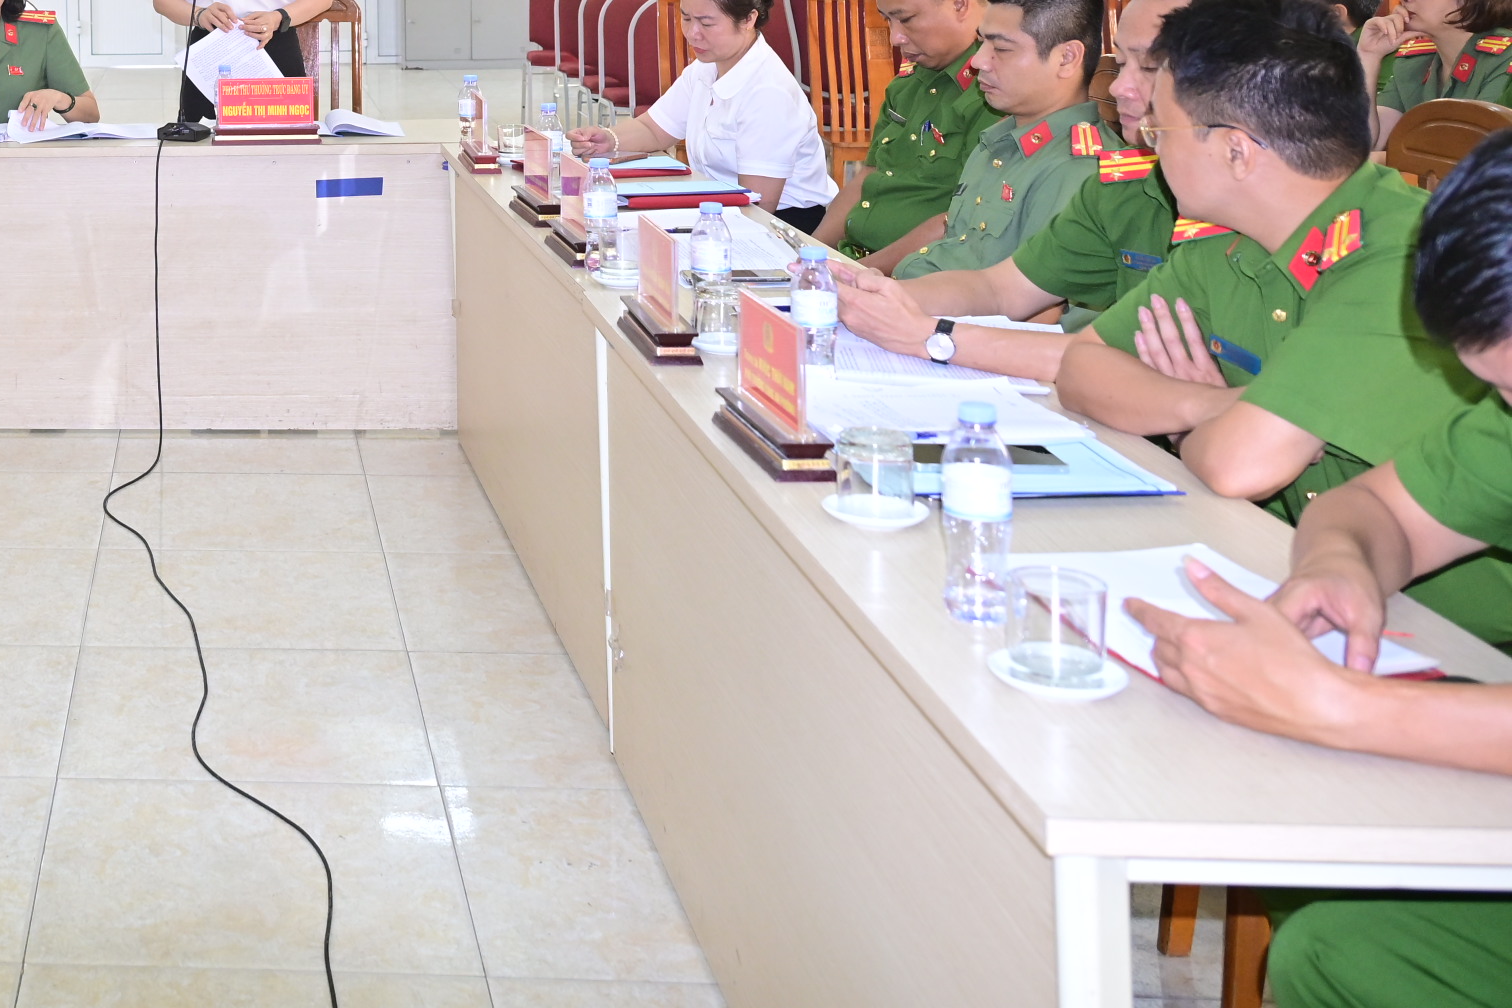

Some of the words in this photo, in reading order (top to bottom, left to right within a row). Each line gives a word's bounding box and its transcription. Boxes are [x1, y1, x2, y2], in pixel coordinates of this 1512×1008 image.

[254, 105, 265, 118] THỊ
[268, 105, 287, 116] MINH
[289, 105, 310, 117] NGỌC
